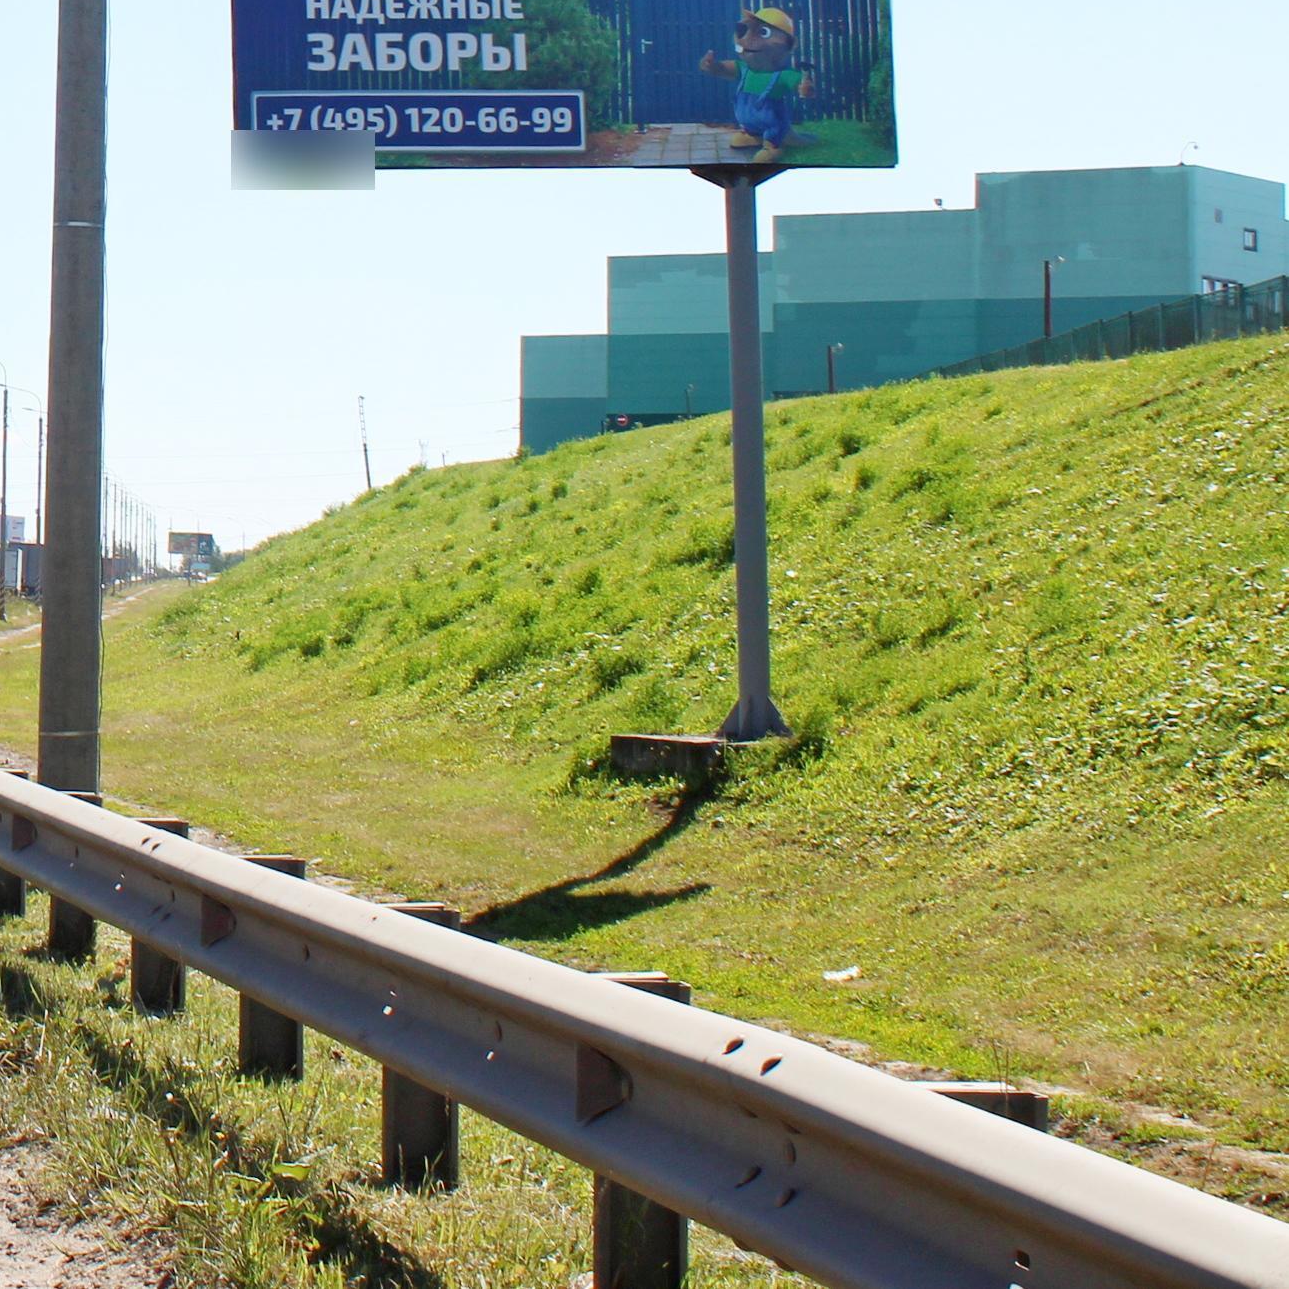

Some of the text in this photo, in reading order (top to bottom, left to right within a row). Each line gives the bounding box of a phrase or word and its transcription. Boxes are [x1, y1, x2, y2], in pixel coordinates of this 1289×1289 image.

[306, 32, 527, 72] ЗАБОРЫ
[266, 104, 572, 138] +7 (495) 120-66-99
